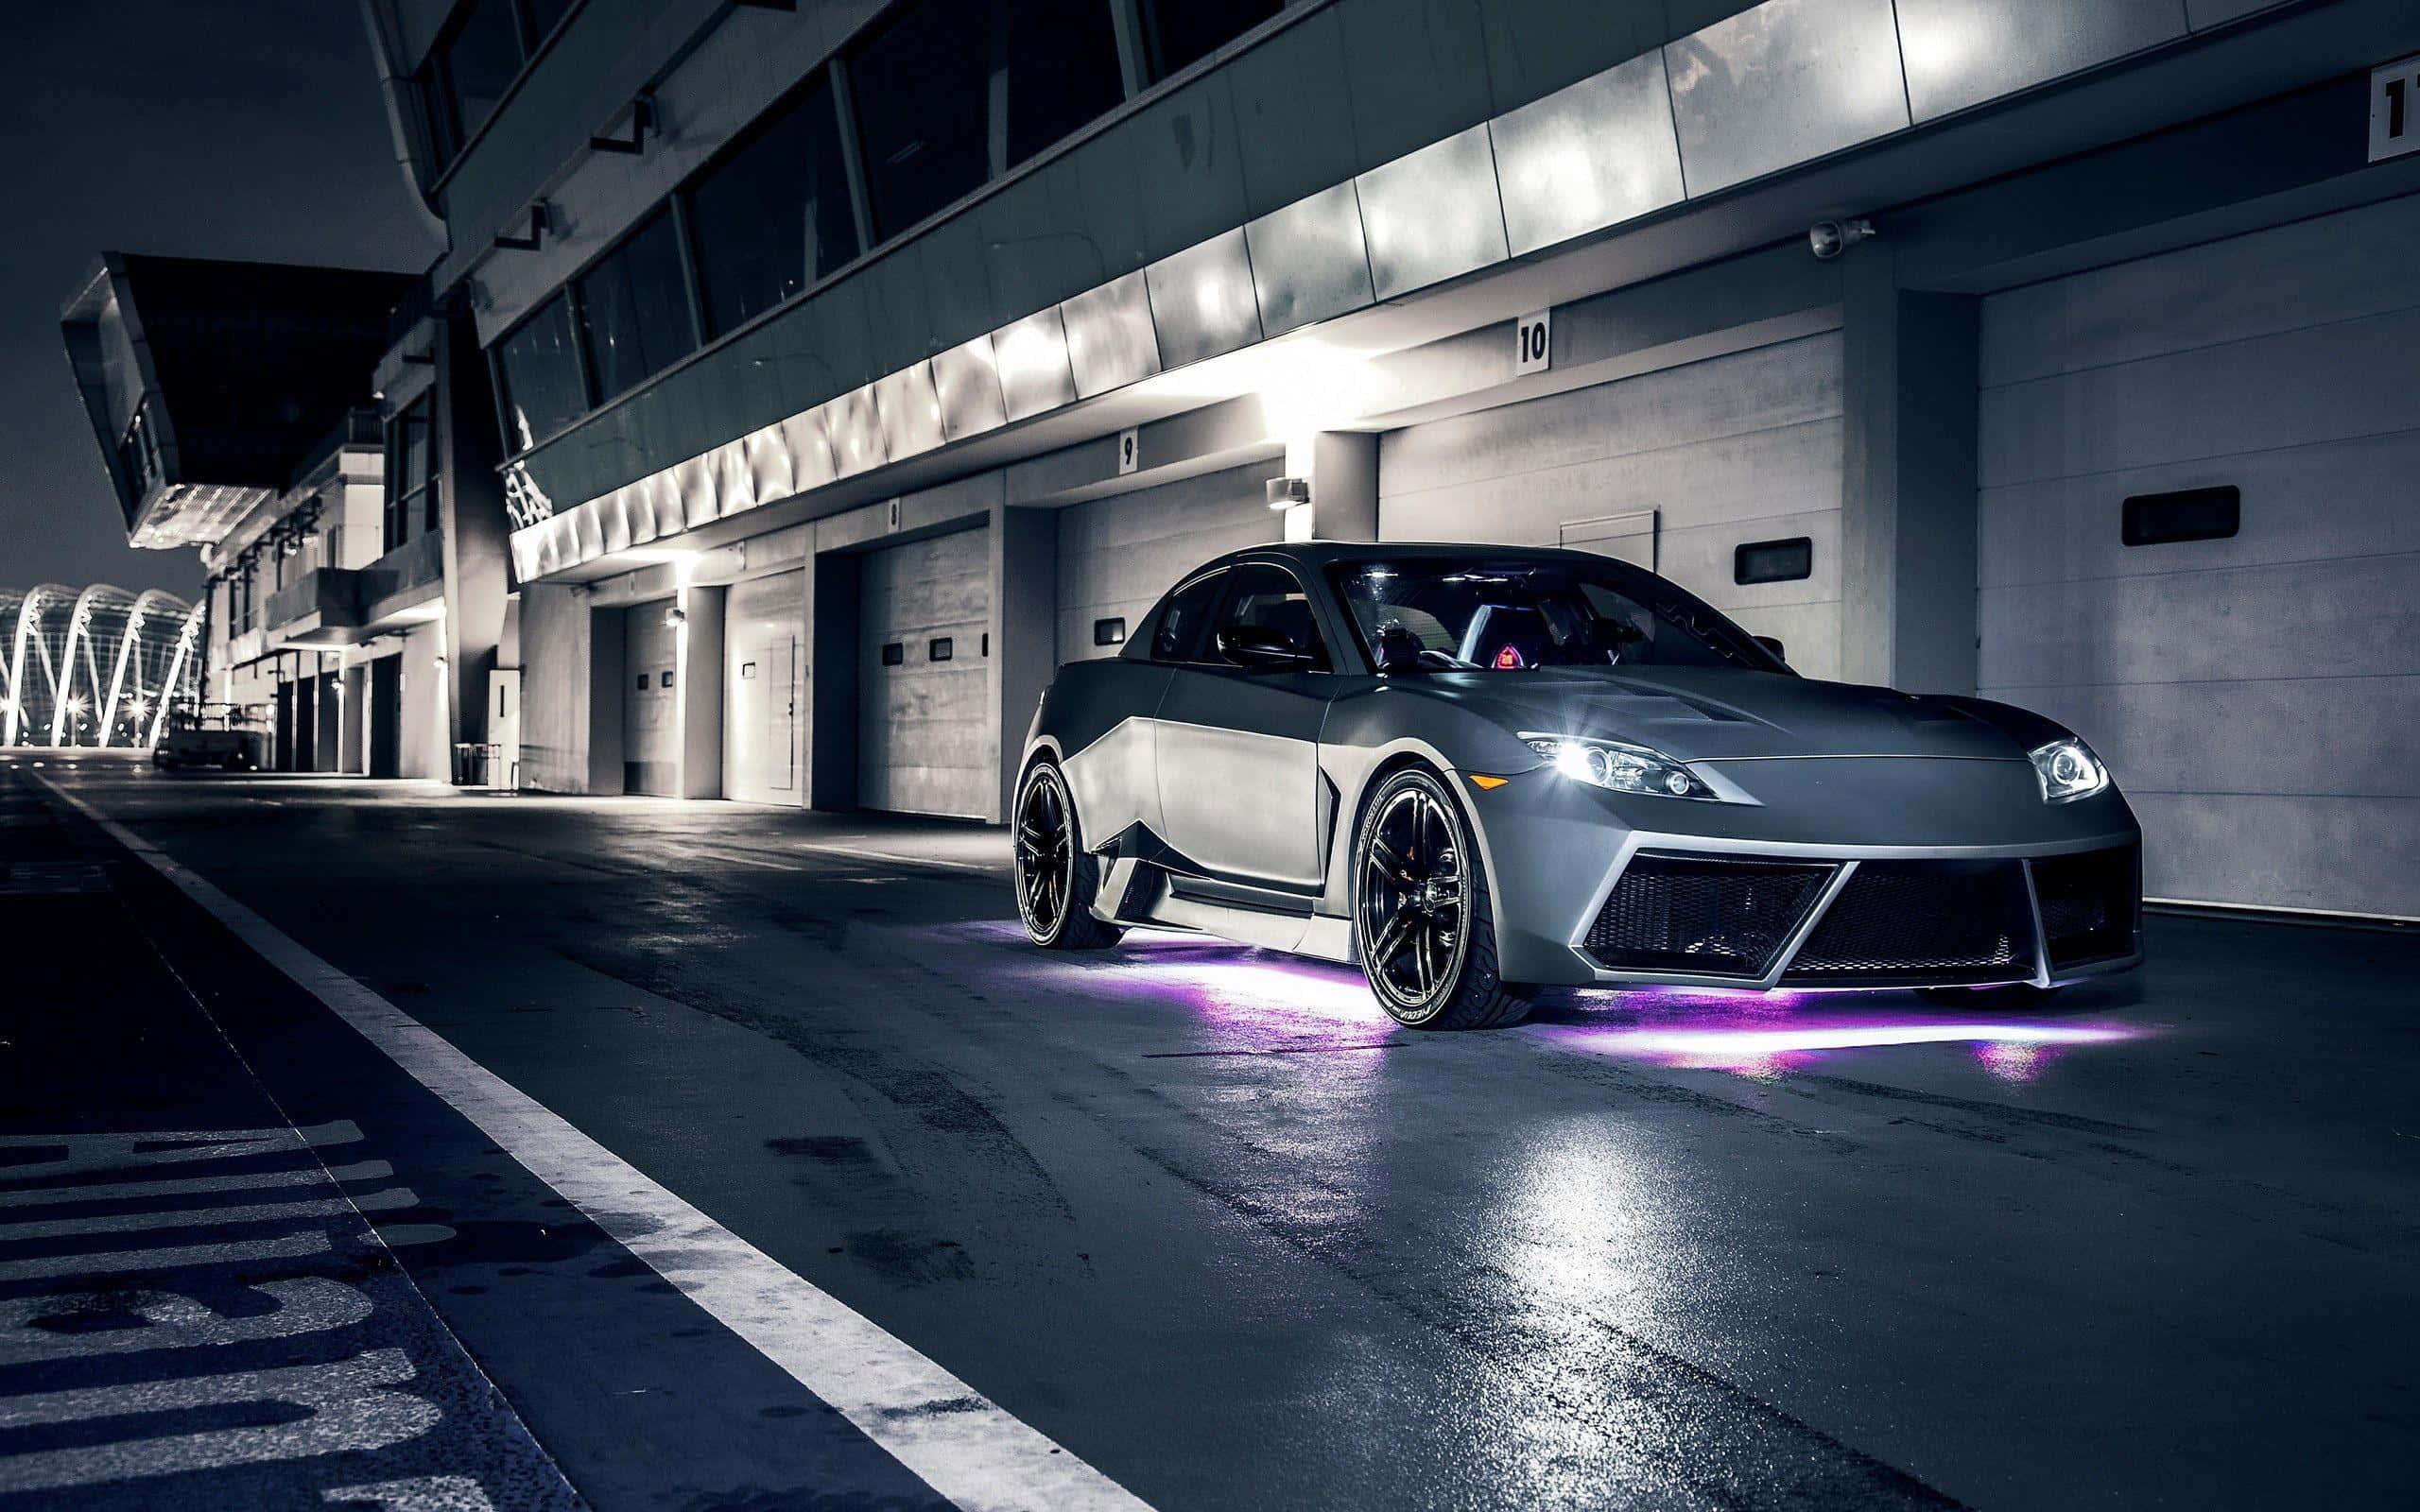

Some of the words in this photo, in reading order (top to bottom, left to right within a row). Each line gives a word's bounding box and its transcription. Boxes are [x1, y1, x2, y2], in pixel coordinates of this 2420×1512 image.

[2385, 77, 2420, 139] 1
[1520, 321, 1547, 364] 10
[1124, 436, 1133, 465] 9
[0, 1119, 493, 1512] Allian
